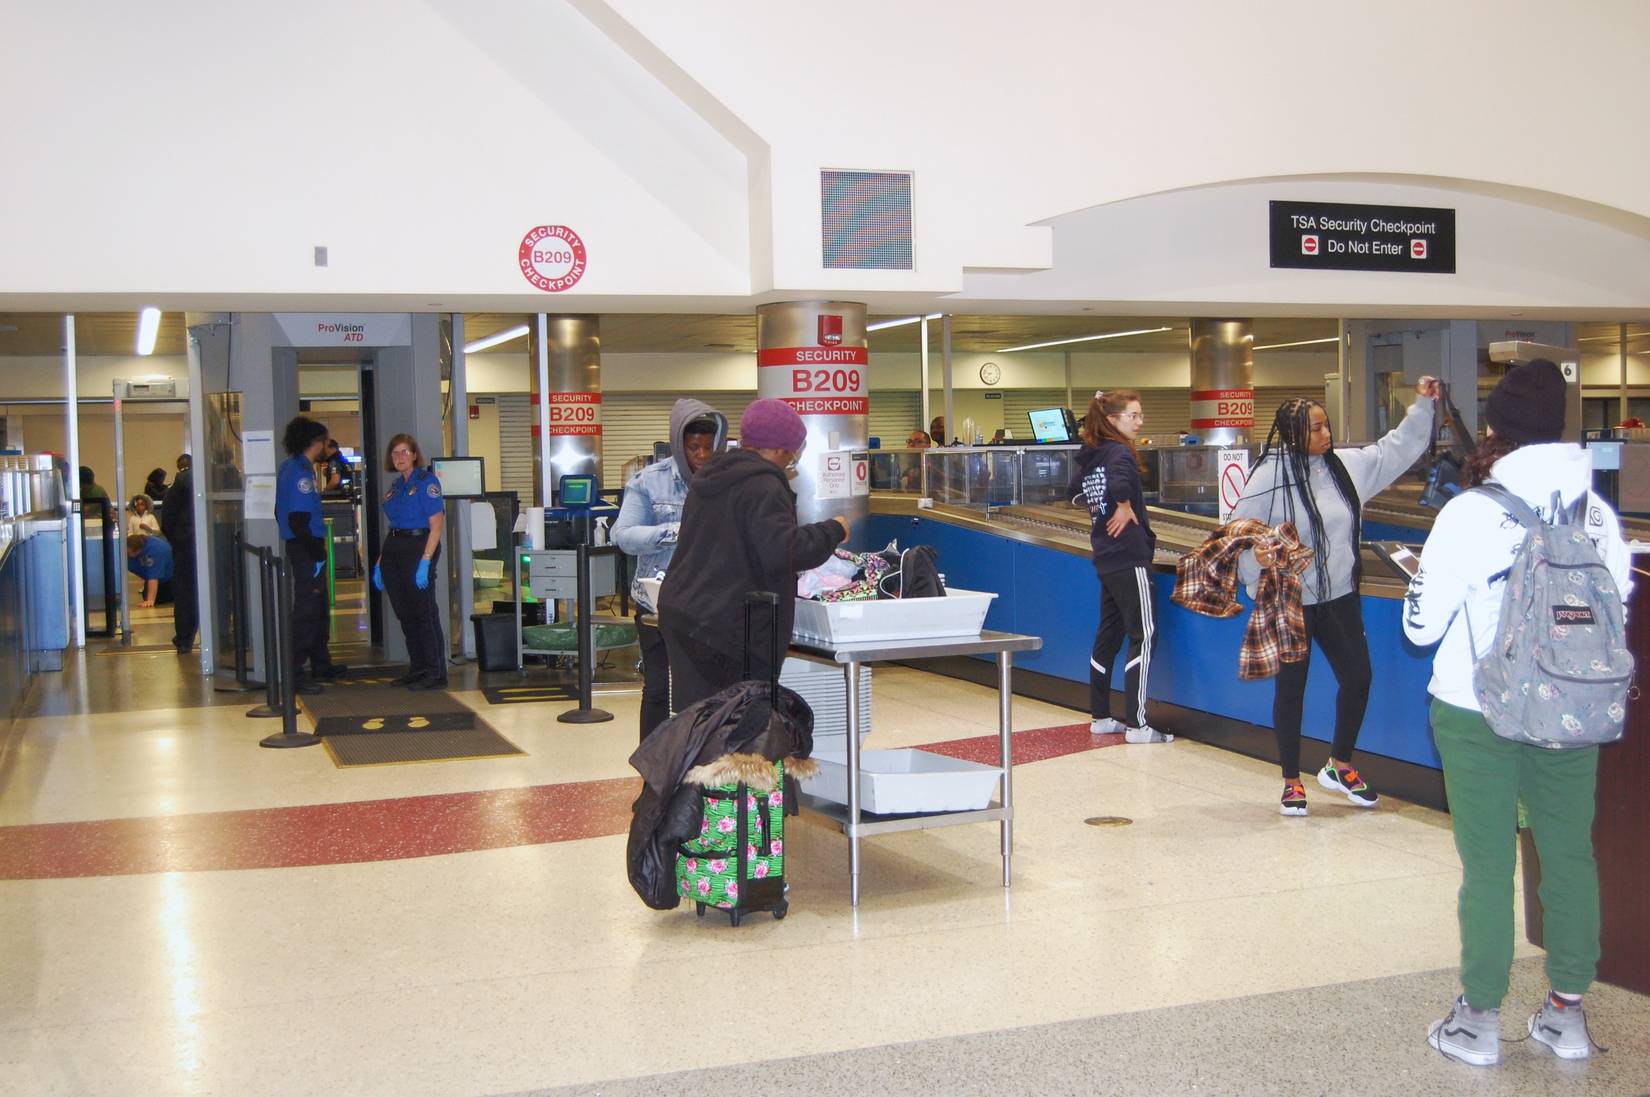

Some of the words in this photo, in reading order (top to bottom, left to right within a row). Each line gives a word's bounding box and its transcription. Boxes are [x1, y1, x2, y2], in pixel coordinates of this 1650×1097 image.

[1291, 215, 1316, 229] TSA
[1320, 216, 1367, 235] Security
[1370, 219, 1436, 236] Checkpoint
[525, 226, 581, 248] SECURITY
[1328, 240, 1345, 253] Do
[1349, 241, 1369, 254] Not
[1372, 242, 1403, 255] Enter
[534, 251, 571, 264] B209
[521, 259, 584, 290] CHECKPOINT
[318, 323, 364, 332] ProVision
[344, 333, 364, 342] ATD
[796, 350, 857, 361] SECURITY
[1564, 365, 1572, 376] 6
[792, 369, 860, 392] B209
[552, 394, 592, 402] SECURITY
[789, 400, 863, 411] CHECKPOINT
[1218, 402, 1252, 415] B209
[550, 407, 595, 421] B209
[1224, 453, 1231, 461] DO
[1232, 453, 1243, 461] NOT
